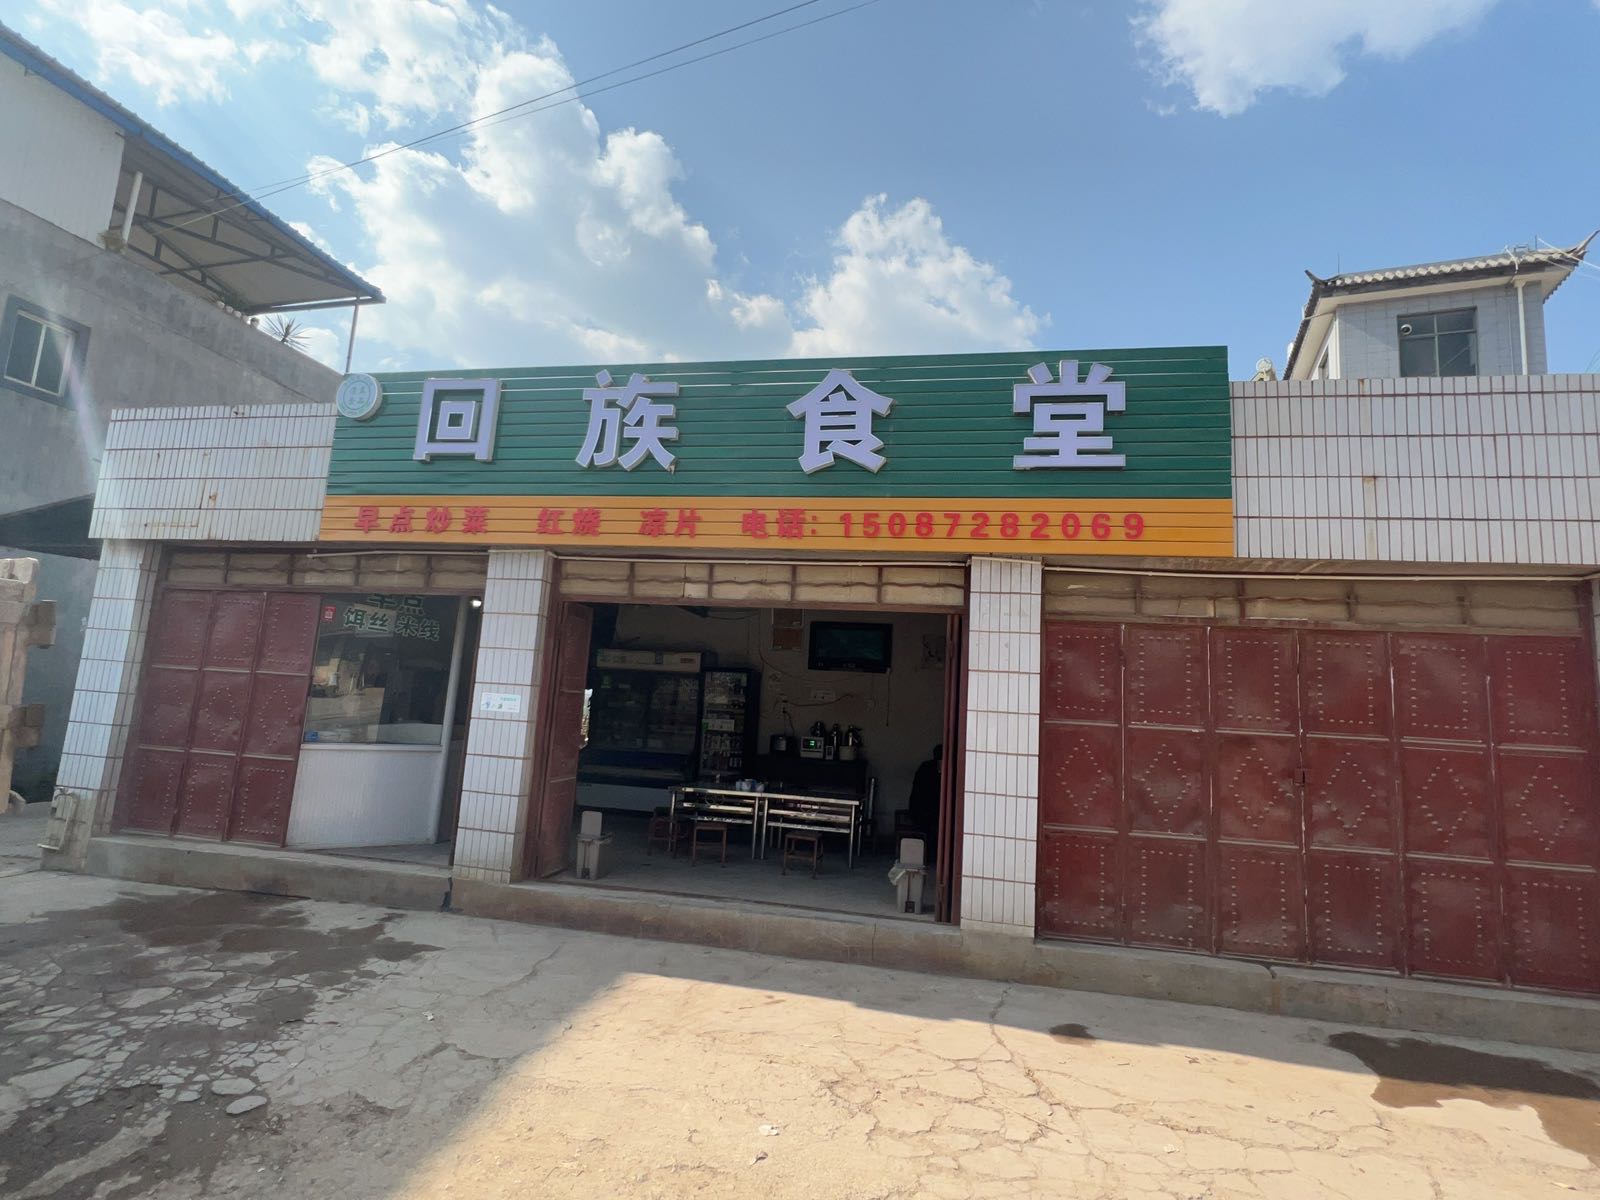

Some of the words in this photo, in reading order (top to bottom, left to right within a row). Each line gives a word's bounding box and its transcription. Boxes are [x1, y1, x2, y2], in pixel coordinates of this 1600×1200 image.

[413, 359, 1126, 474] 回族食堂
[354, 505, 490, 534] 早点炒菜
[536, 507, 601, 536] 红烧
[343, 607, 441, 642] 饵丝米线
